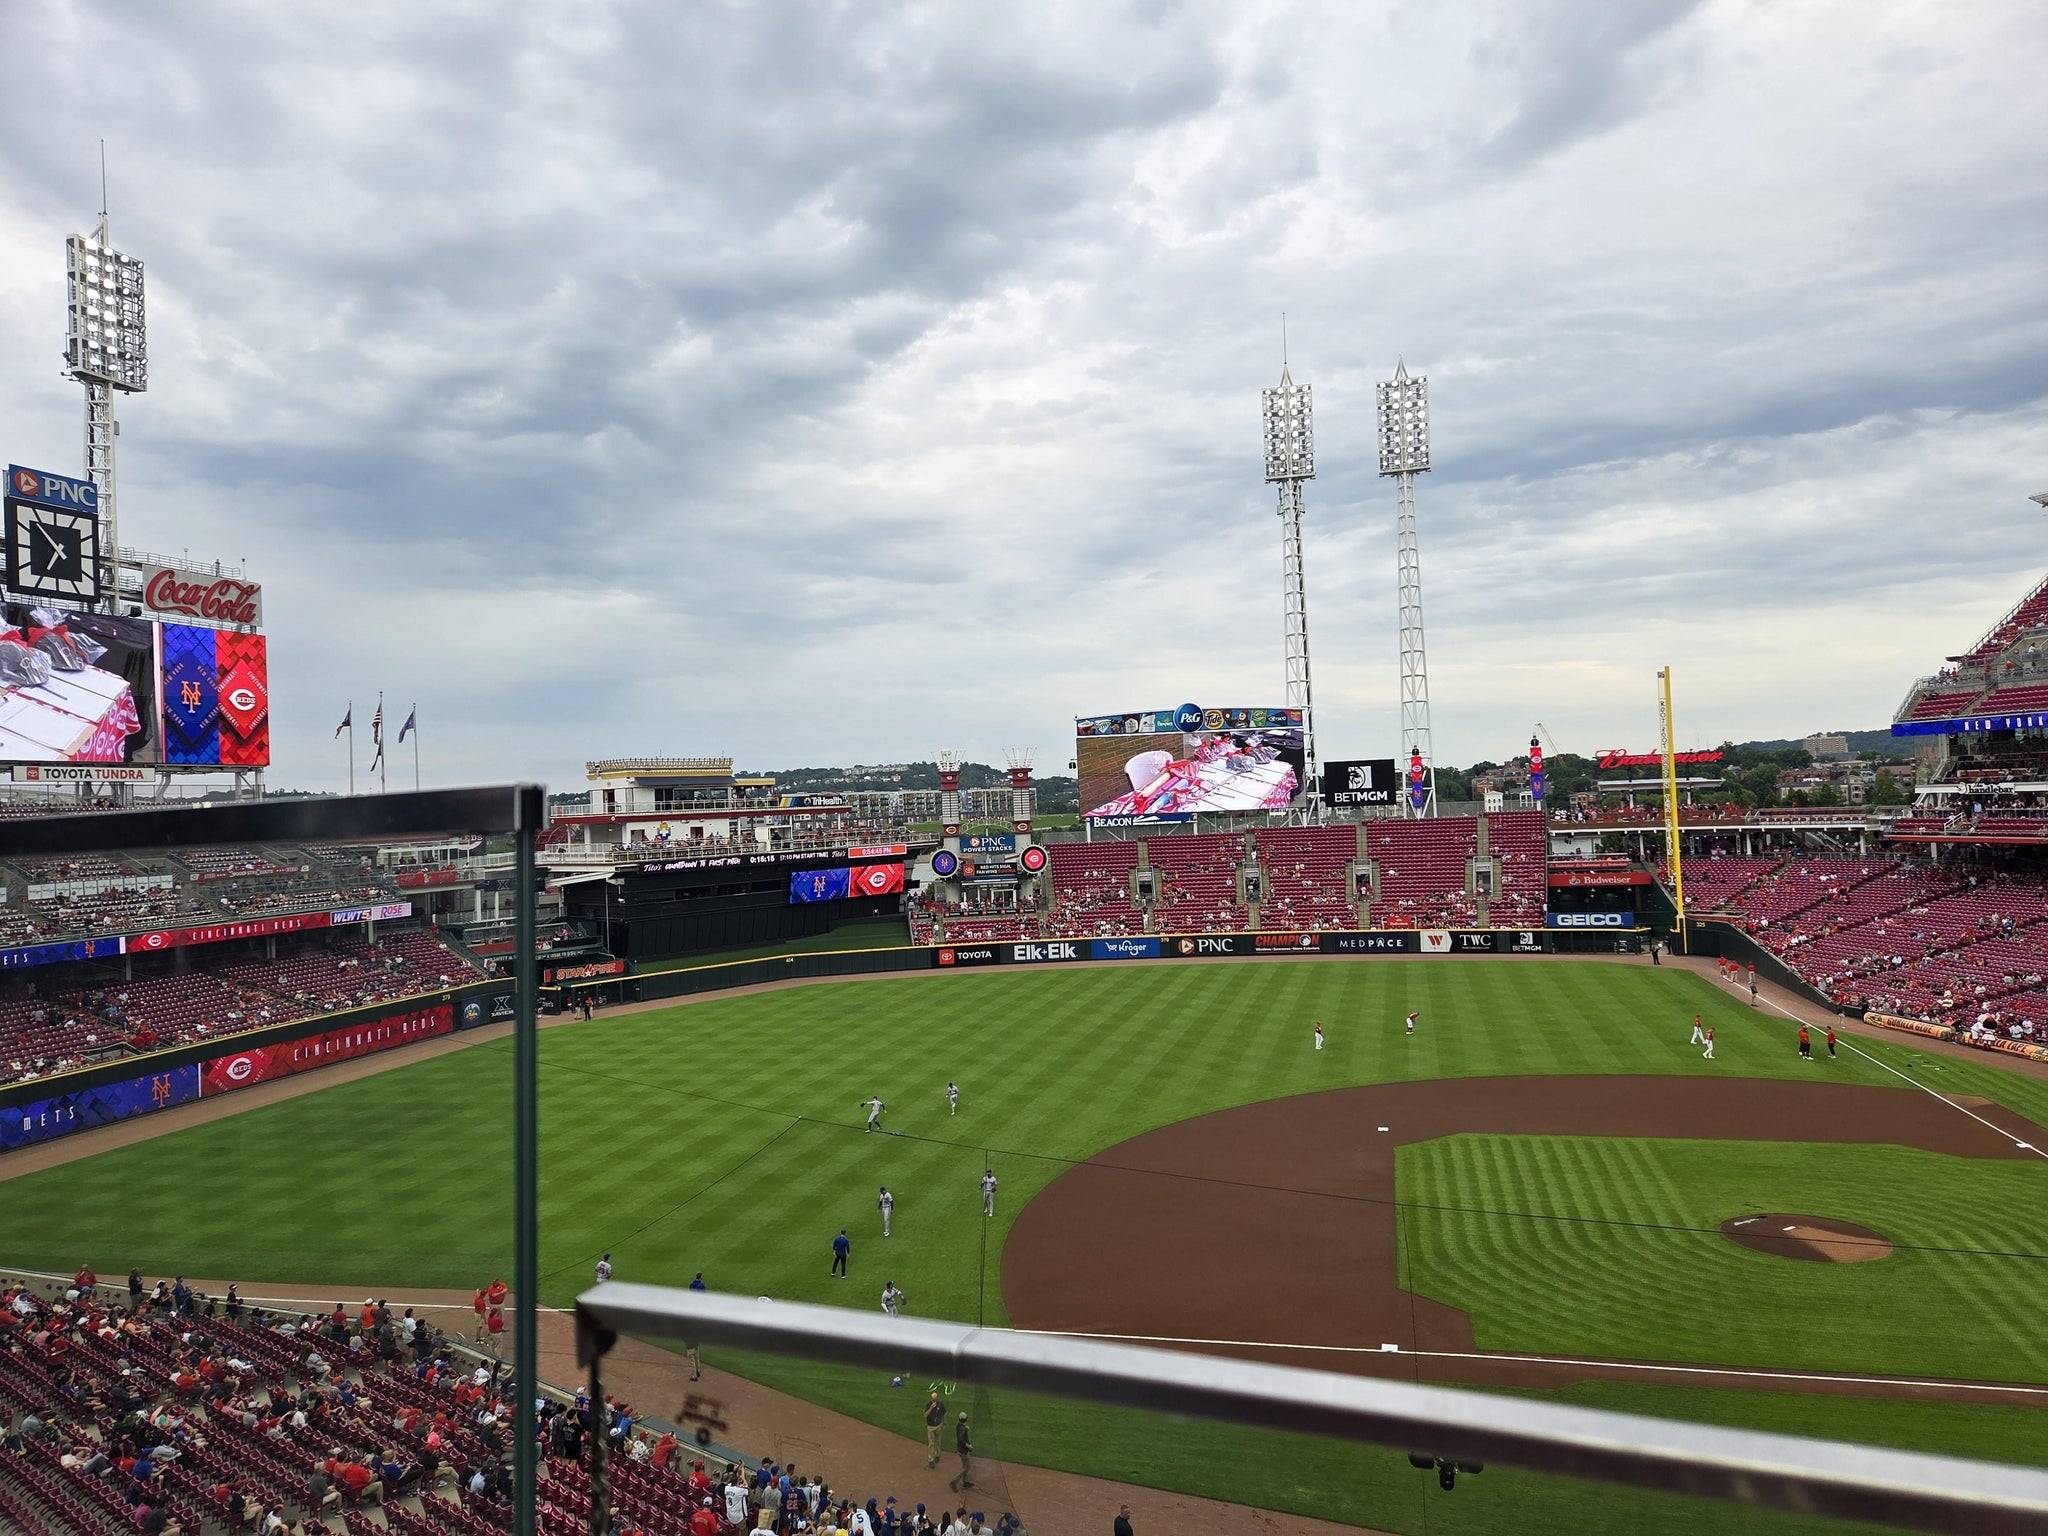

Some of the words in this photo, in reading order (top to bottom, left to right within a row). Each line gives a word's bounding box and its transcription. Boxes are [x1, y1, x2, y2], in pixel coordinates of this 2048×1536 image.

[41, 475, 96, 507] PNC
[145, 569, 262, 624] Coca-Cola
[236, 696, 256, 704] REDS
[1180, 712, 1201, 723] P&G
[1205, 714, 1222, 725] Tide
[1965, 719, 1991, 731] NEW
[2006, 716, 2044, 728] YORK
[44, 768, 92, 779] TOYOTA
[95, 768, 144, 780] TUNDRA
[1968, 784, 2013, 793] handlebar
[812, 796, 842, 806] TriHealth
[1334, 791, 1388, 802] BETMGM
[1094, 816, 1132, 827] BEACON
[982, 836, 1006, 847] PNC
[644, 863, 661, 872] Tito's
[708, 858, 725, 867] FIRST
[1584, 876, 1631, 884] Budweiser
[380, 905, 403, 919] ROSE
[1557, 913, 1621, 926] GEICO
[192, 922, 265, 941] CINCINNATI
[274, 919, 301, 930] REDS
[1197, 938, 1234, 952] PNC
[1339, 938, 1404, 947] MEDPACE
[1427, 935, 1443, 946] W
[1459, 934, 1491, 946] TWC
[1118, 940, 1147, 956] Kroger
[957, 950, 992, 960] TOYOTA
[491, 1009, 515, 1018] XAVIER
[1887, 1017, 1915, 1030] GORILLA
[1914, 1023, 1932, 1034] GLUE
[294, 1026, 390, 1062] CINCINNATI
[402, 1015, 436, 1034] REDS
[234, 1063, 252, 1074] REDS
[23, 1105, 75, 1131] METS
[856, 1513, 864, 1524] 5
